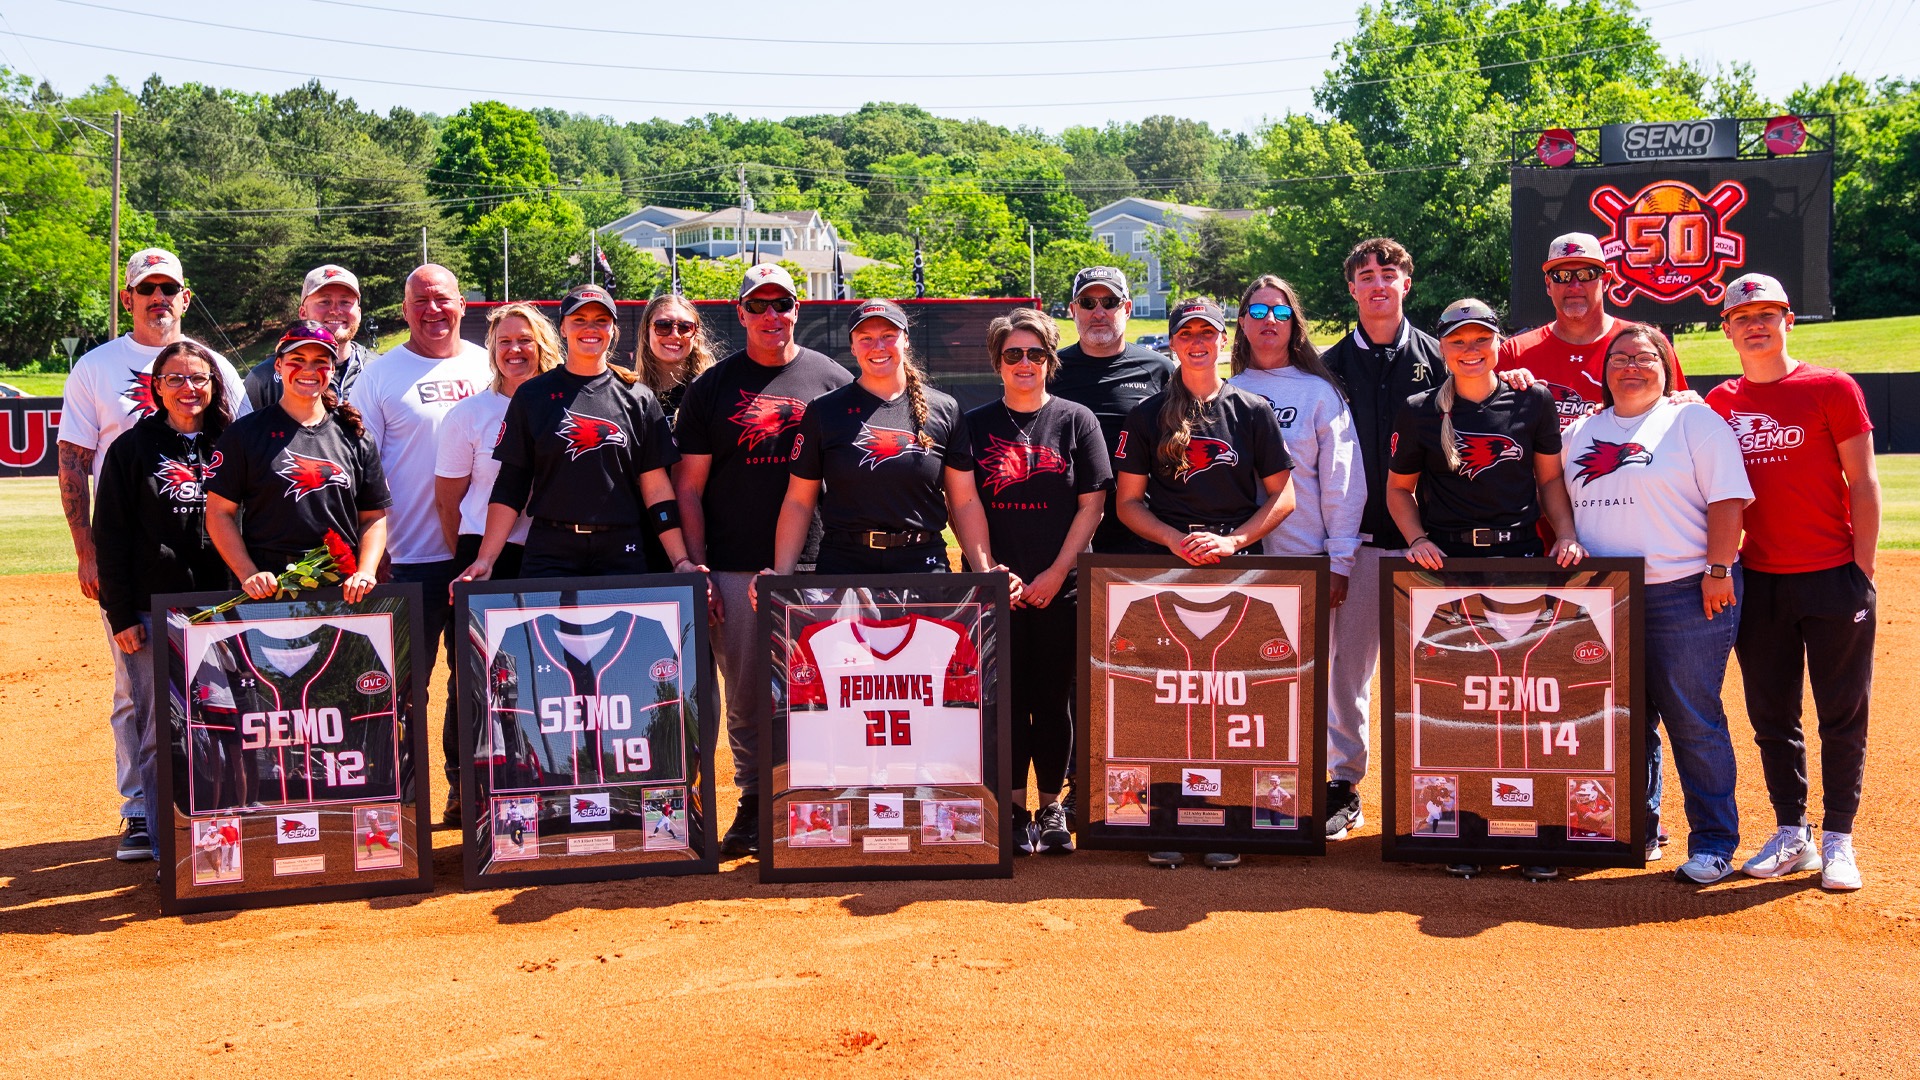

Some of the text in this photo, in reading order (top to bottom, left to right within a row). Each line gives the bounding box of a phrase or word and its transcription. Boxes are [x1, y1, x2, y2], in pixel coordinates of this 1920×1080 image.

[1626, 123, 1711, 150] SEMO
[1632, 147, 1702, 157] REDHAWKS
[1626, 213, 1710, 268] 50
[1657, 274, 1692, 284] SEMO
[791, 433, 805, 460] 6
[1741, 428, 1801, 451] SEMO
[991, 501, 1049, 510] SOFTBALL
[1574, 497, 1636, 508] SOFTBALL
[1266, 645, 1286, 655] OVC
[1579, 647, 1600, 658] OVC
[655, 664, 674, 676] OVC
[796, 669, 811, 679] OVC
[363, 674, 382, 688] OVC
[1154, 670, 1248, 706] SEMO
[839, 674, 934, 708] REDHAWKS
[1463, 675, 1561, 713] SEMO
[540, 694, 632, 734] SEMO
[241, 707, 344, 750] SEMO
[863, 710, 912, 747] 26
[1227, 714, 1265, 748] 21
[1539, 721, 1580, 756] 14
[611, 737, 652, 773] 19
[322, 751, 366, 787] 12
[1191, 782, 1219, 792] SEMO
[1502, 793, 1530, 802] SEMO
[580, 806, 608, 817] SEMO
[878, 810, 900, 819] SEMO
[288, 827, 316, 839] SEMO
